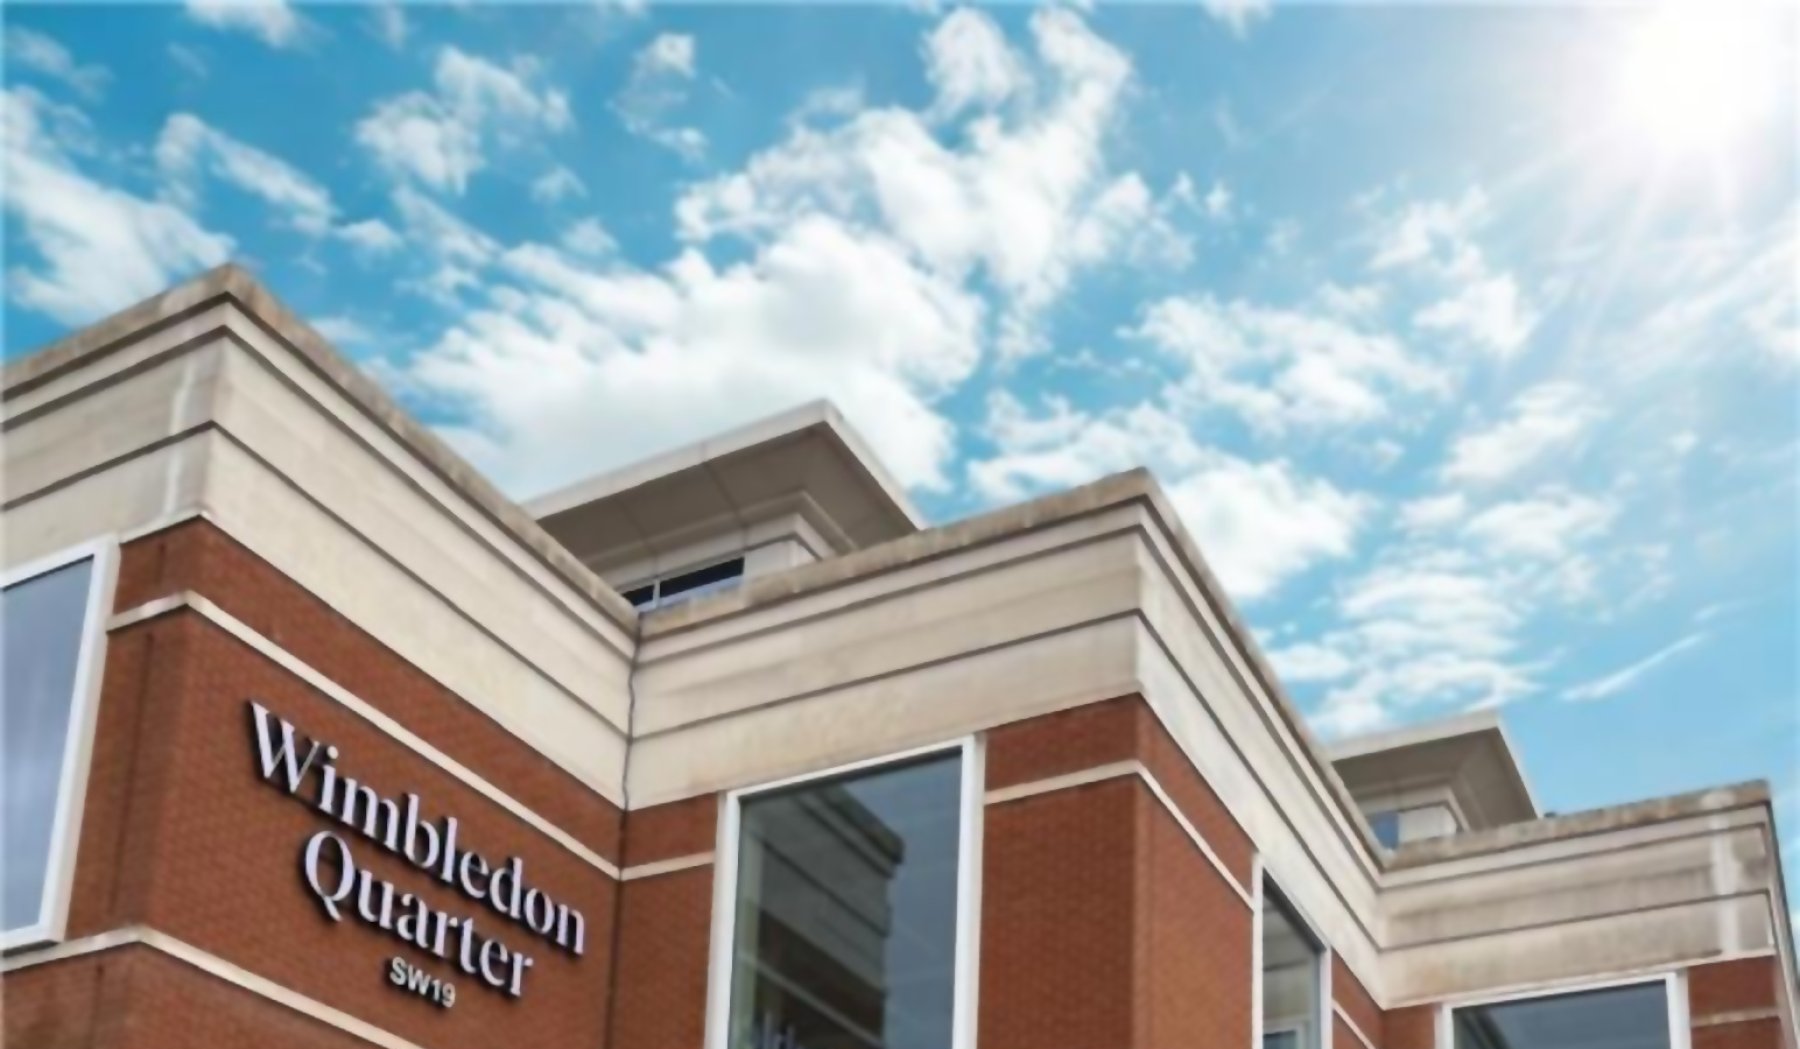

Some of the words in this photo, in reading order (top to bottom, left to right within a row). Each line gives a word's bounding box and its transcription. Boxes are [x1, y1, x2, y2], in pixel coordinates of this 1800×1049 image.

[250, 700, 585, 956] Wimbledon
[304, 830, 534, 997] Quarter
[389, 956, 457, 1008] SW19
